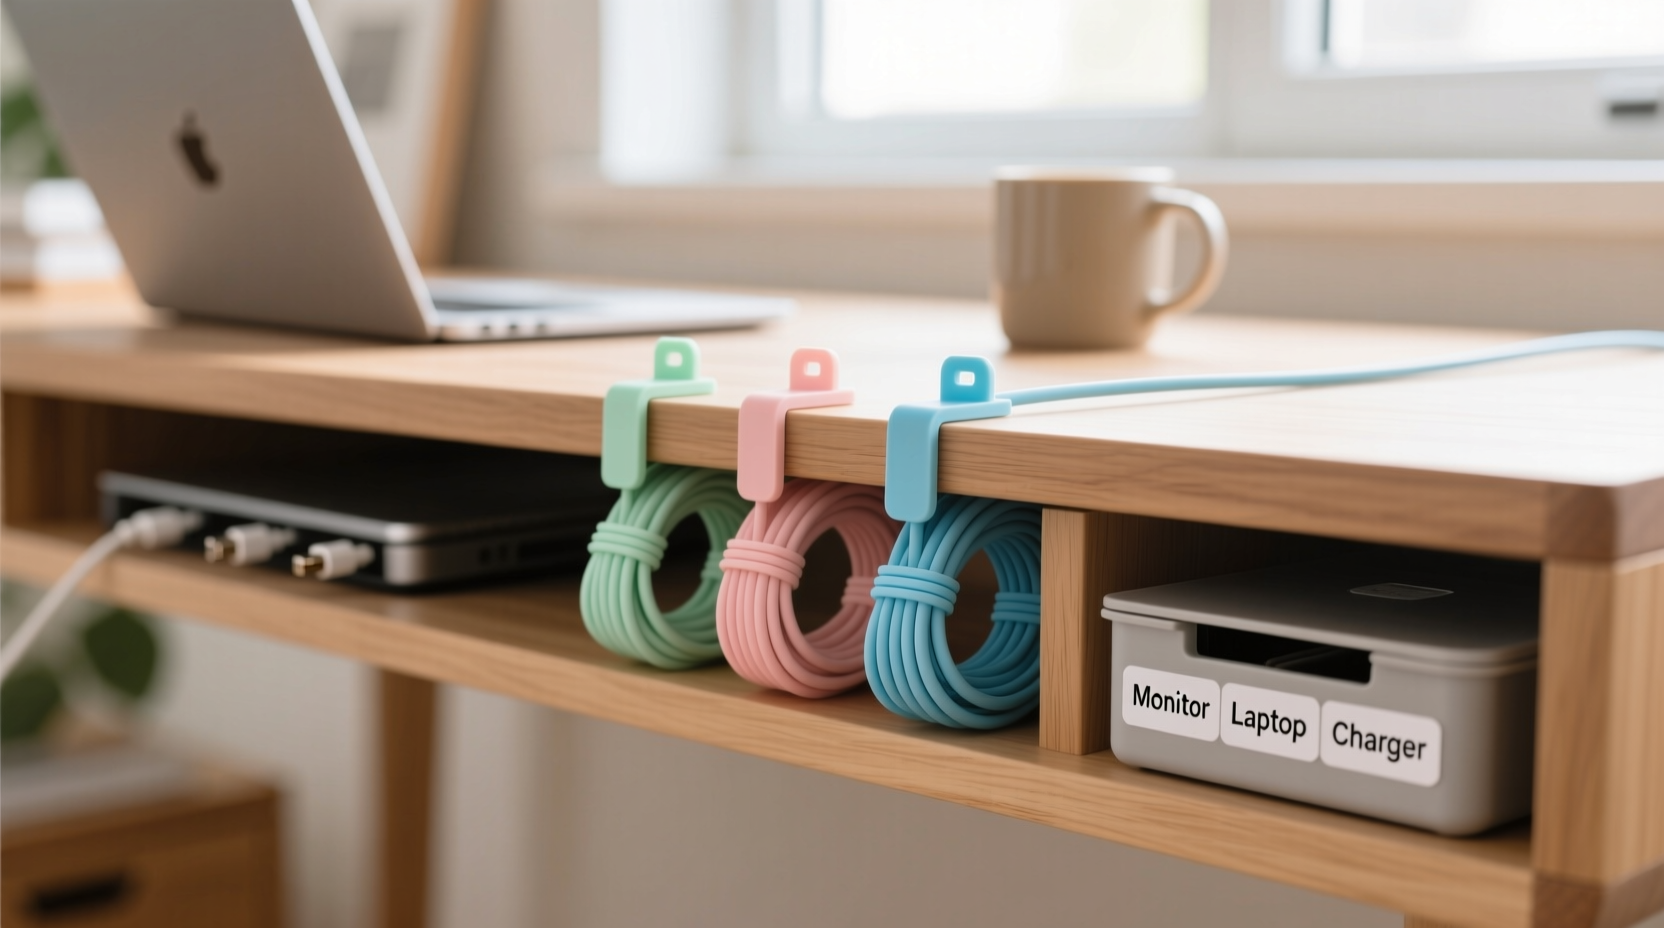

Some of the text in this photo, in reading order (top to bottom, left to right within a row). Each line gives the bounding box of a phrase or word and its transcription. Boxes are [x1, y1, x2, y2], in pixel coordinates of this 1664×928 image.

[1133, 683, 1211, 720] Monitor
[1231, 701, 1307, 743] Laptop
[1332, 721, 1427, 763] Charger
